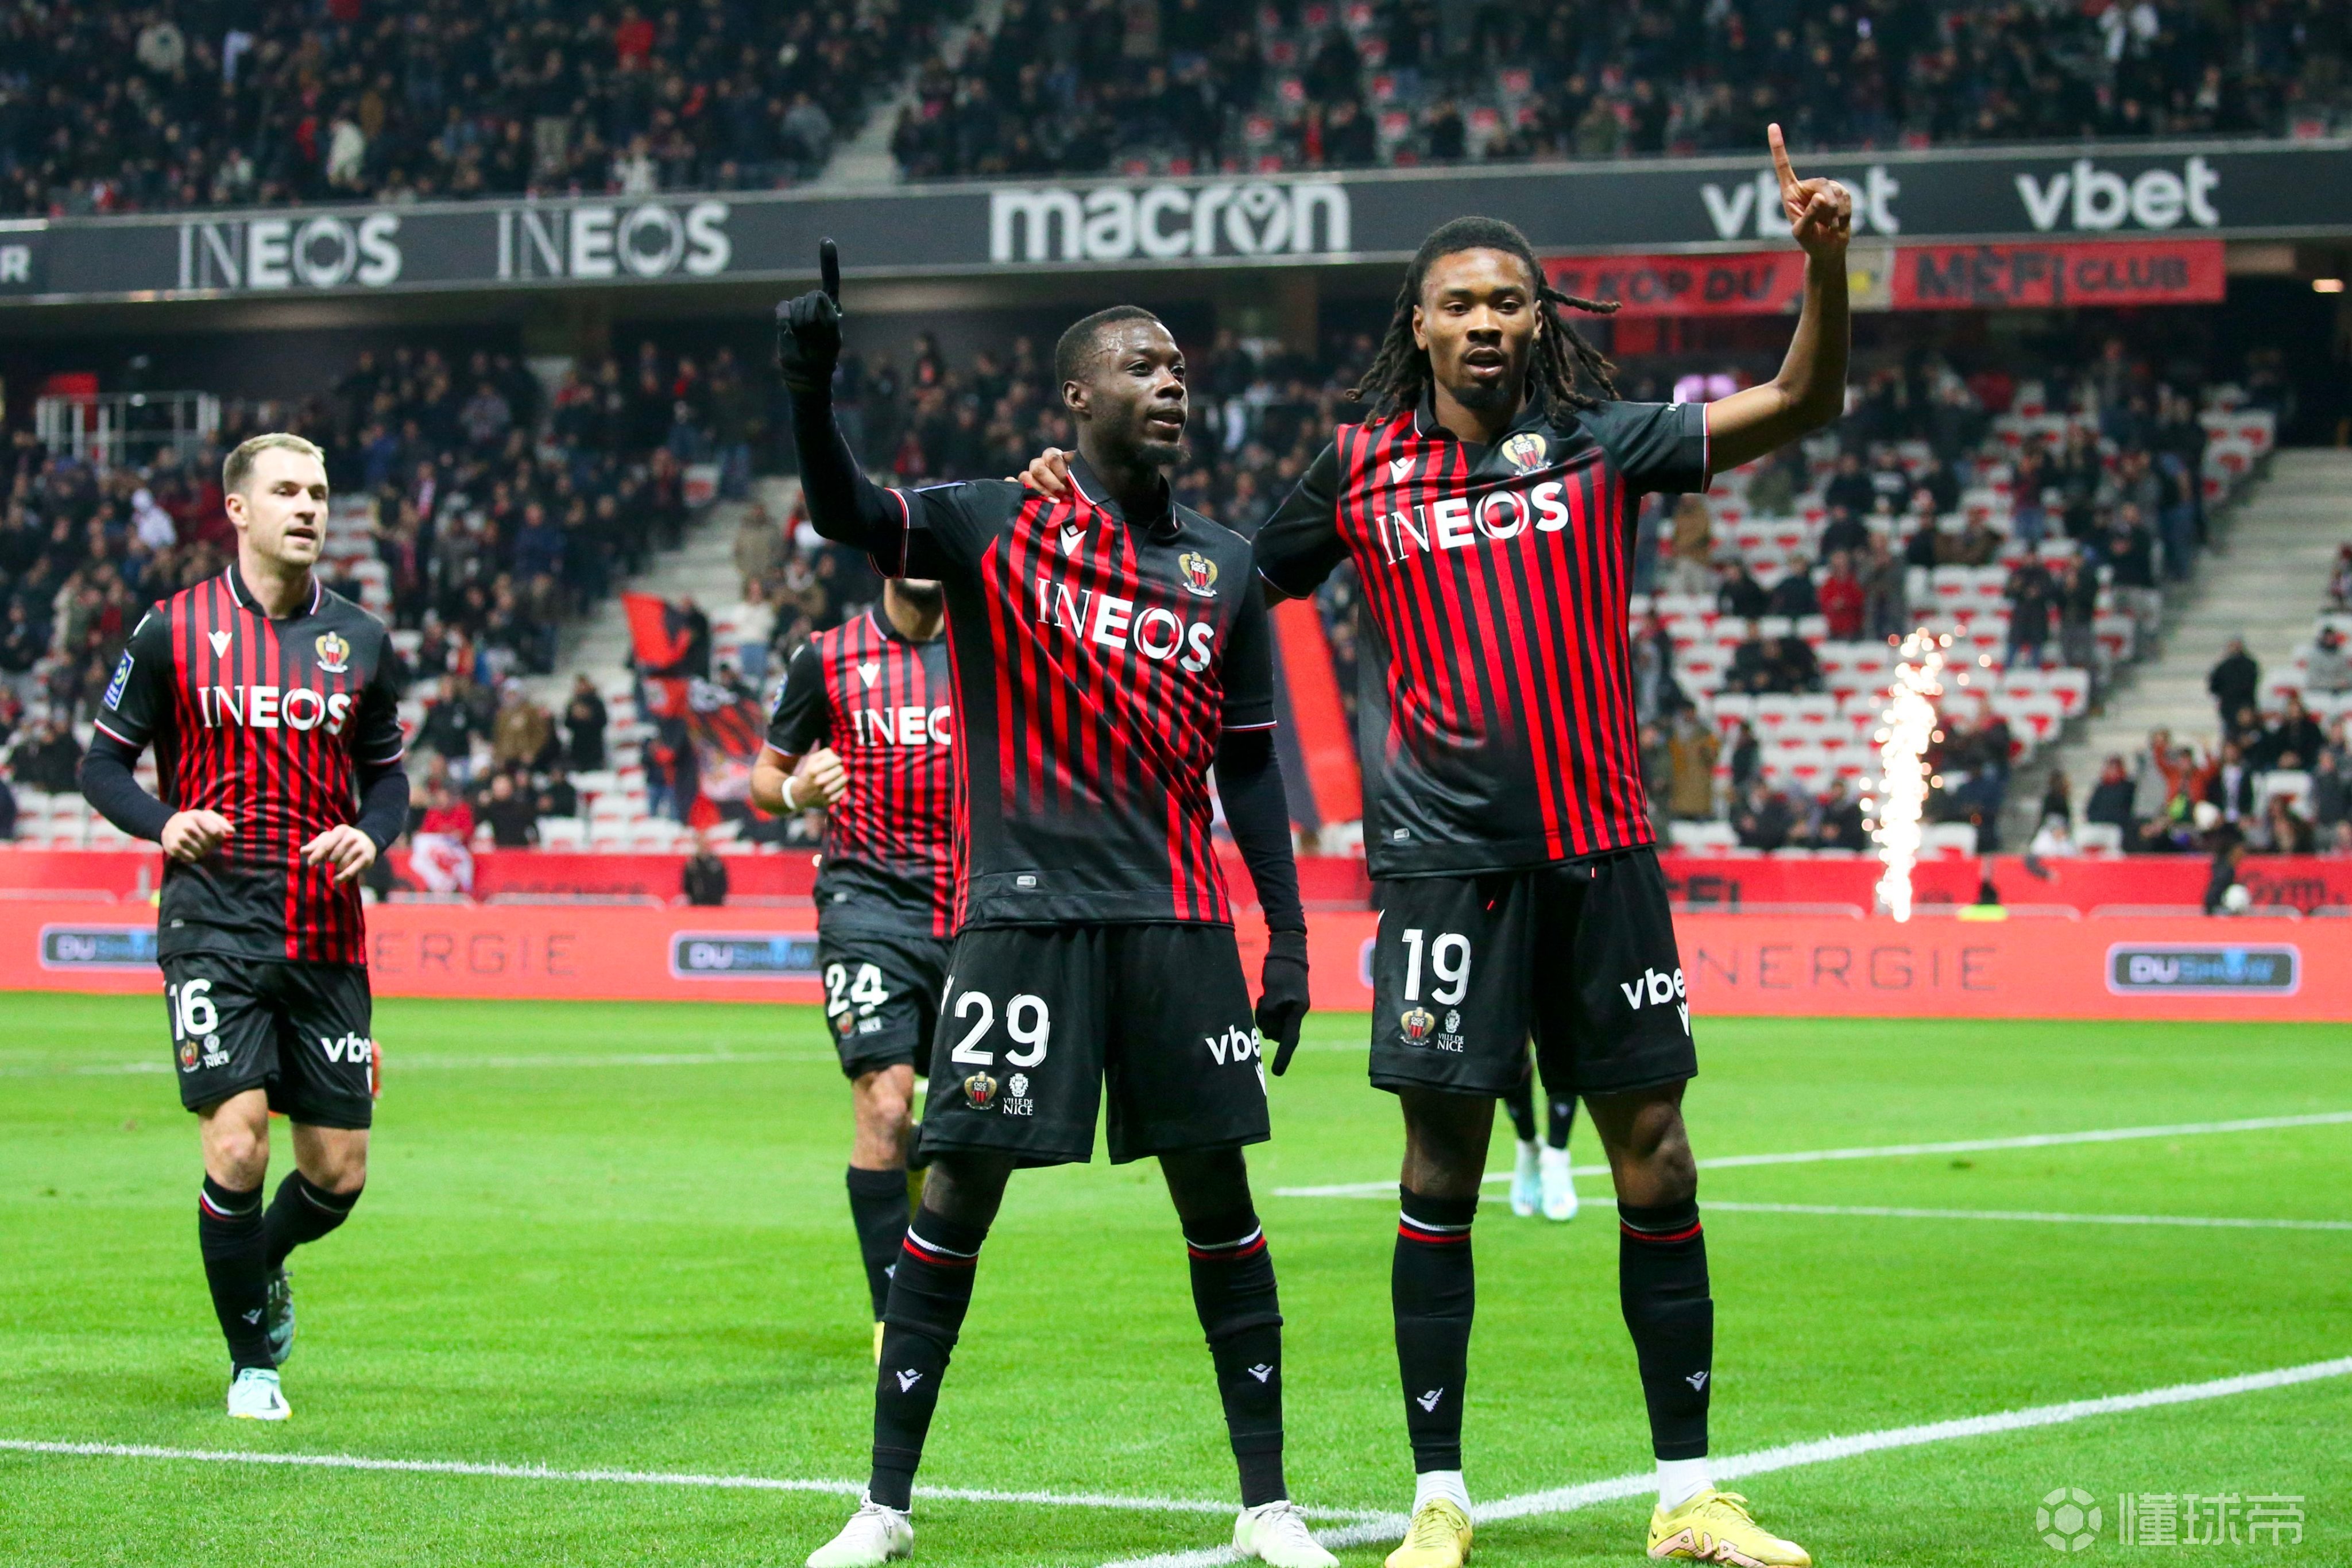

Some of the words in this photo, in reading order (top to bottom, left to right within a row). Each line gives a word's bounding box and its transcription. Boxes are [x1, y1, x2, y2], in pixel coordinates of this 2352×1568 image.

[1701, 165, 1898, 239] vbt
[2014, 156, 2220, 230] vbet
[496, 201, 732, 282] INEOS
[989, 181, 1351, 262] macron
[178, 212, 402, 289] INEOS
[1376, 482, 1569, 565] INEOS
[1037, 578, 1214, 672] INEOS
[198, 685, 351, 735] INEOS
[852, 706, 951, 746] INEO
[375, 932, 575, 975] ERGIE
[1402, 928, 1471, 1005] 19
[1697, 944, 1997, 990] NERGIE
[169, 978, 218, 1040] 16
[826, 962, 889, 1017] 24
[1620, 967, 1686, 1009] vbe
[320, 1031, 372, 1063] vbe
[951, 990, 1050, 1067] 29
[1205, 1024, 1261, 1065] vbe
[1437, 1039, 1464, 1052] NICE
[1438, 1033, 1454, 1041] VILLE
[1003, 1104, 1033, 1116] NICE
